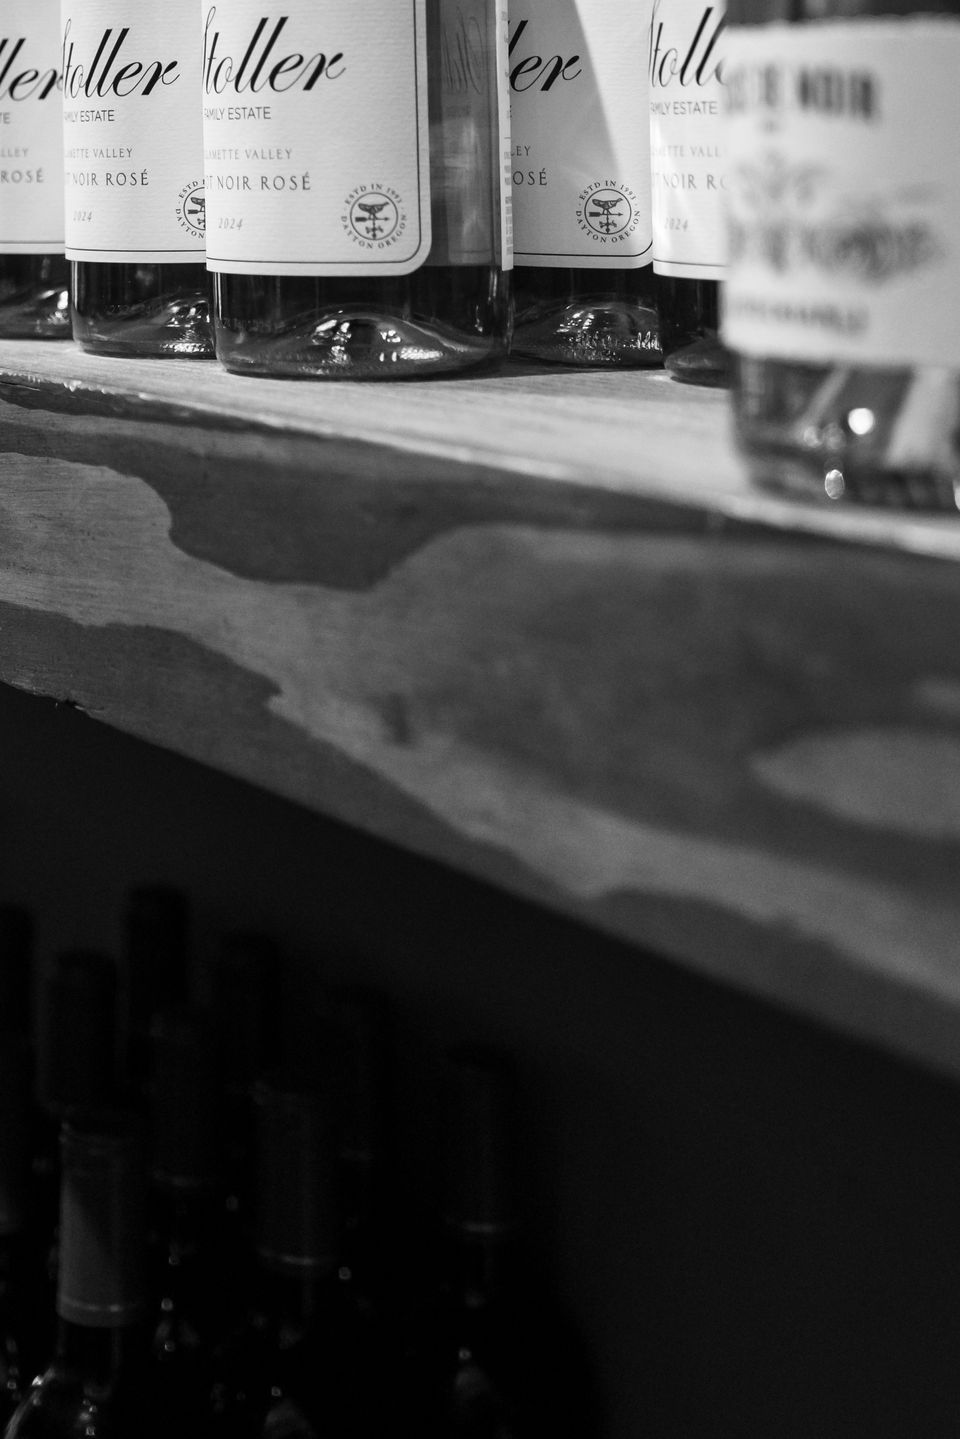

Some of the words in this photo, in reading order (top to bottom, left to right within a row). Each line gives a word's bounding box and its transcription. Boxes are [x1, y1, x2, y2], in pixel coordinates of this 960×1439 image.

[80, 109, 116, 123] ESTATE
[227, 106, 272, 120] ESTATE
[672, 100, 719, 116] ESTATE
[93, 148, 134, 159] VALLEY
[244, 148, 293, 160] VALLEY
[0, 166, 45, 184] ROSÉ
[72, 172, 99, 187] NOIR
[105, 169, 150, 187] ROSÉ
[217, 175, 252, 190] NOIR
[260, 171, 311, 191] ROSÉ
[513, 167, 548, 187] OSÉ
[178, 180, 199, 199] ESTD
[371, 183, 383, 191] IN
[579, 181, 601, 201] ESTD
[605, 179, 617, 188] IN
[620, 184, 638, 201] 1993
[218, 218, 243, 231] 2024
[341, 215, 373, 249] DAYTON
[377, 214, 408, 249] OREGON
[576, 210, 607, 244] DAYTON
[611, 210, 641, 244] OREGON
